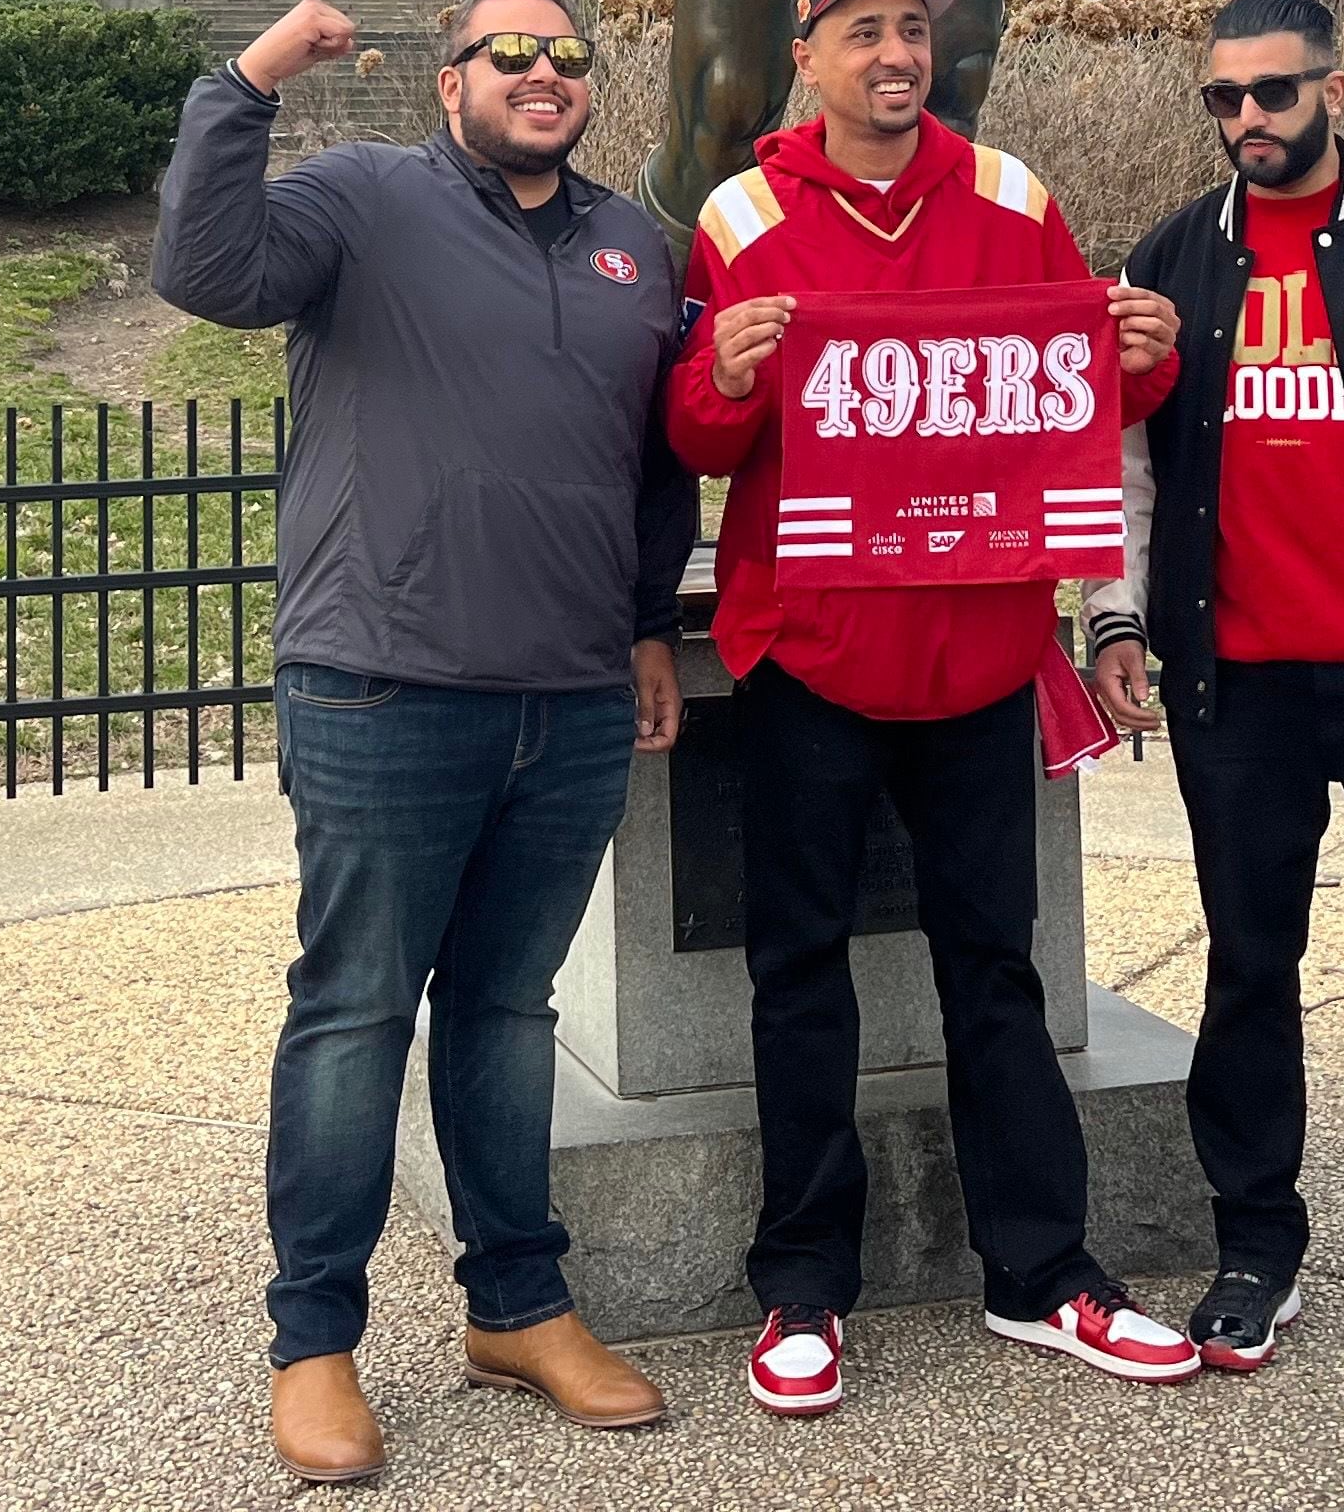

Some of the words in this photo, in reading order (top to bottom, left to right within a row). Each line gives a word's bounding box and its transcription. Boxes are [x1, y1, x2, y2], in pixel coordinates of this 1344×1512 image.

[800, 332, 1096, 439] 49ERS
[910, 495, 969, 506] UNITED
[895, 506, 969, 518] AIRLINES
[930, 535, 956, 548] SAP
[871, 545, 903, 555] CISCO
